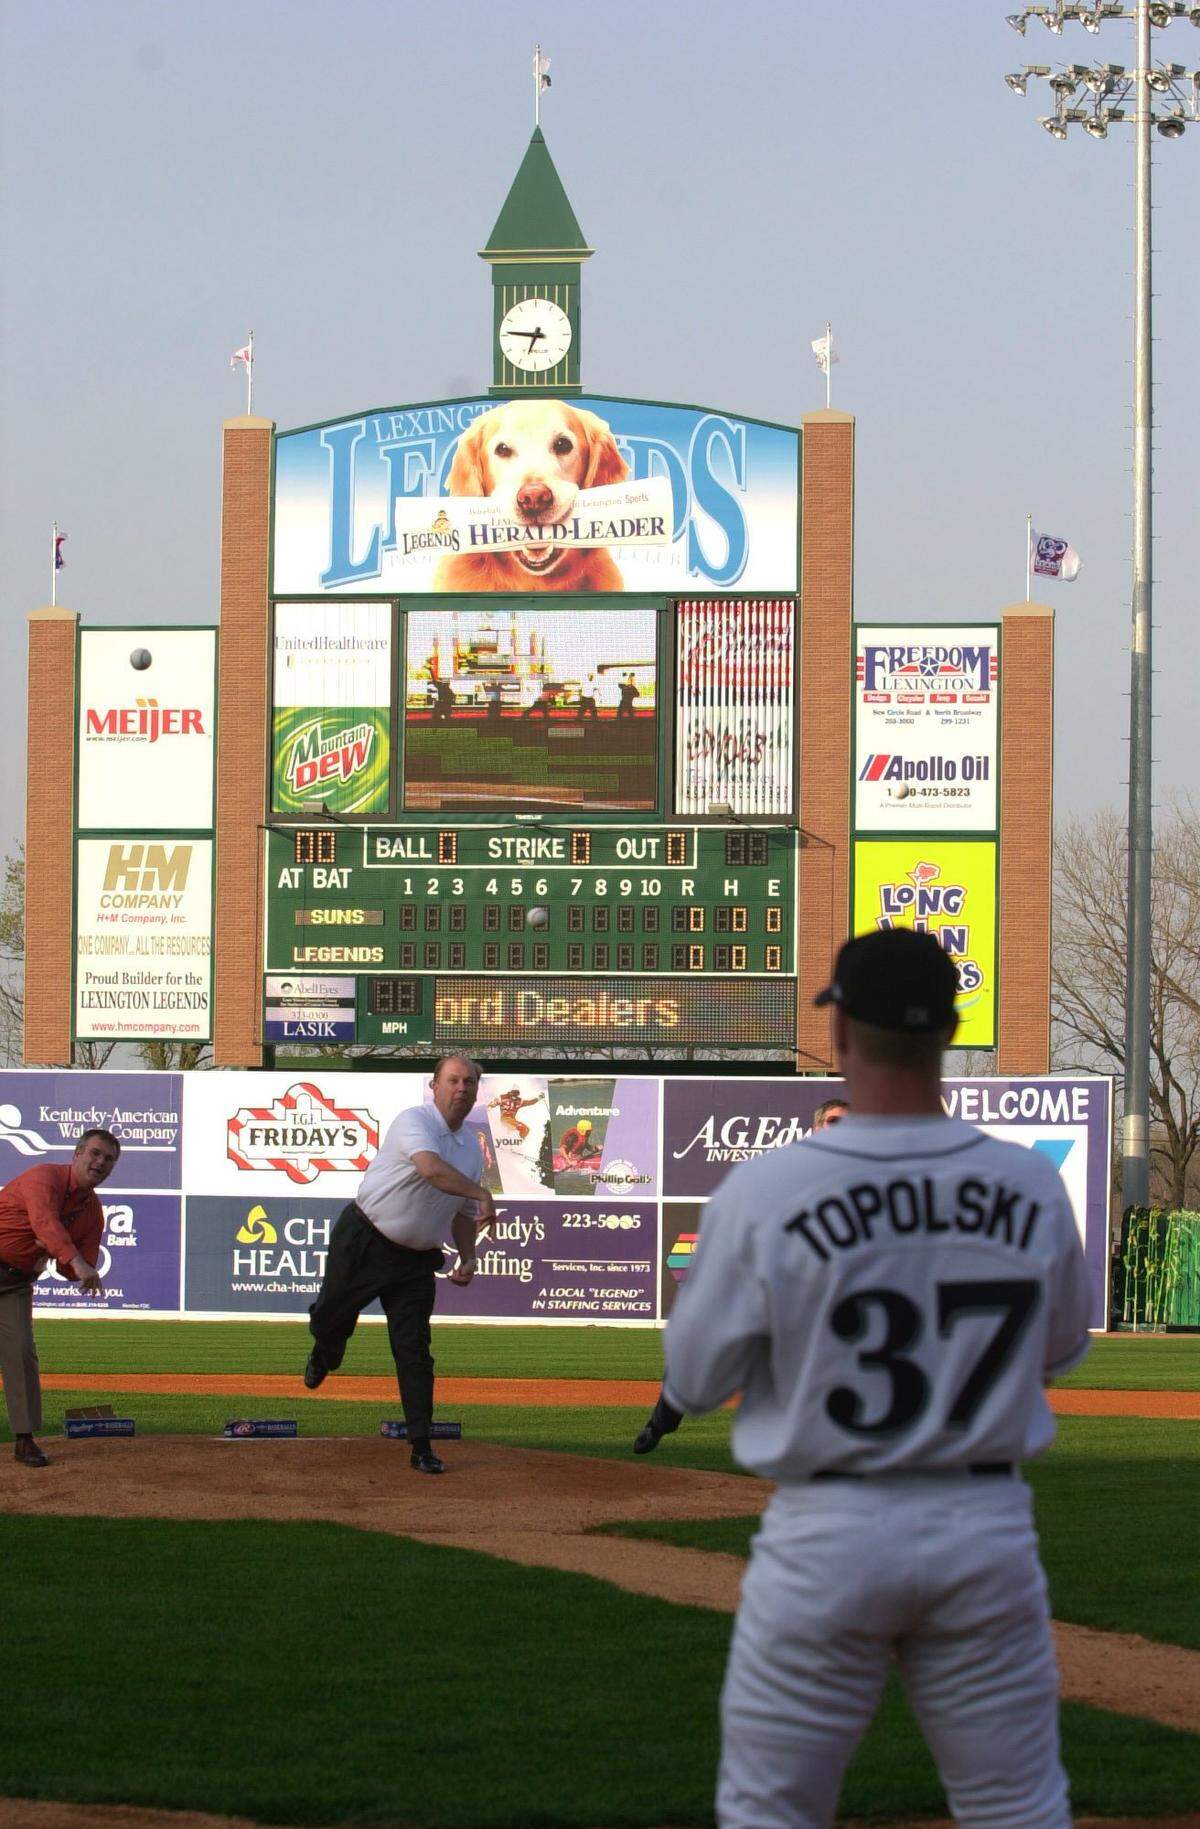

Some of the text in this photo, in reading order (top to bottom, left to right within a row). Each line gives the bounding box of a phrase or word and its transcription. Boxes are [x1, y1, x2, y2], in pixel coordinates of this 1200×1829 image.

[468, 516, 665, 546] HERALD-LEADER
[403, 529, 460, 555] LEGENDS
[864, 646, 991, 691] FREEDOM
[882, 677, 975, 690] LEXINGTON
[86, 698, 206, 743] MEIJER
[288, 723, 367, 777] Mountain
[883, 755, 990, 781] Apollo Oil
[376, 837, 432, 858] BALL
[438, 832, 457, 864] 0
[488, 837, 565, 858] STRIKE
[572, 832, 590, 864] 0
[616, 838, 660, 859] OUT
[667, 832, 685, 864] 0
[277, 868, 352, 889] AT BAT
[403, 879, 780, 896] 1 2 3 4 5 6 7 8 9 10 R H E
[100, 894, 184, 909] COMPANY
[881, 886, 966, 916] LONG
[121, 914, 168, 925] Company,
[170, 914, 188, 924] Inc.
[310, 909, 365, 924] SUNS
[78, 936, 93, 955] ONE
[151, 936, 165, 955] THE
[166, 936, 210, 955] RESOURCES
[293, 946, 384, 962] LEGENDS
[85, 971, 203, 986] Proud Builder for the
[81, 991, 208, 1010] LEXINGTON LEGENDS
[435, 991, 679, 1027] ord Dealers
[91, 1021, 200, 1034] www.hmcompany.com
[283, 1022, 336, 1037] LASIK
[382, 1022, 407, 1034] MPH
[39, 1106, 179, 1127] Kentucky-American
[555, 1105, 620, 1117] Adventure
[249, 1125, 358, 1147] FRIDAY'S
[495, 1136, 524, 1147] your
[784, 1178, 1040, 1263] TOPOLSKI
[107, 1234, 137, 1247] Bank
[284, 1218, 330, 1245] CH
[233, 1249, 329, 1277] HEALT
[552, 1262, 651, 1273] Services, Inc. since 1973
[232, 1281, 322, 1294] www.cha-healt
[539, 1288, 645, 1299] A LOCAL "LEGEND"
[532, 1300, 652, 1312] IN STAFFING SERVICES
[825, 1279, 1042, 1437] 37
